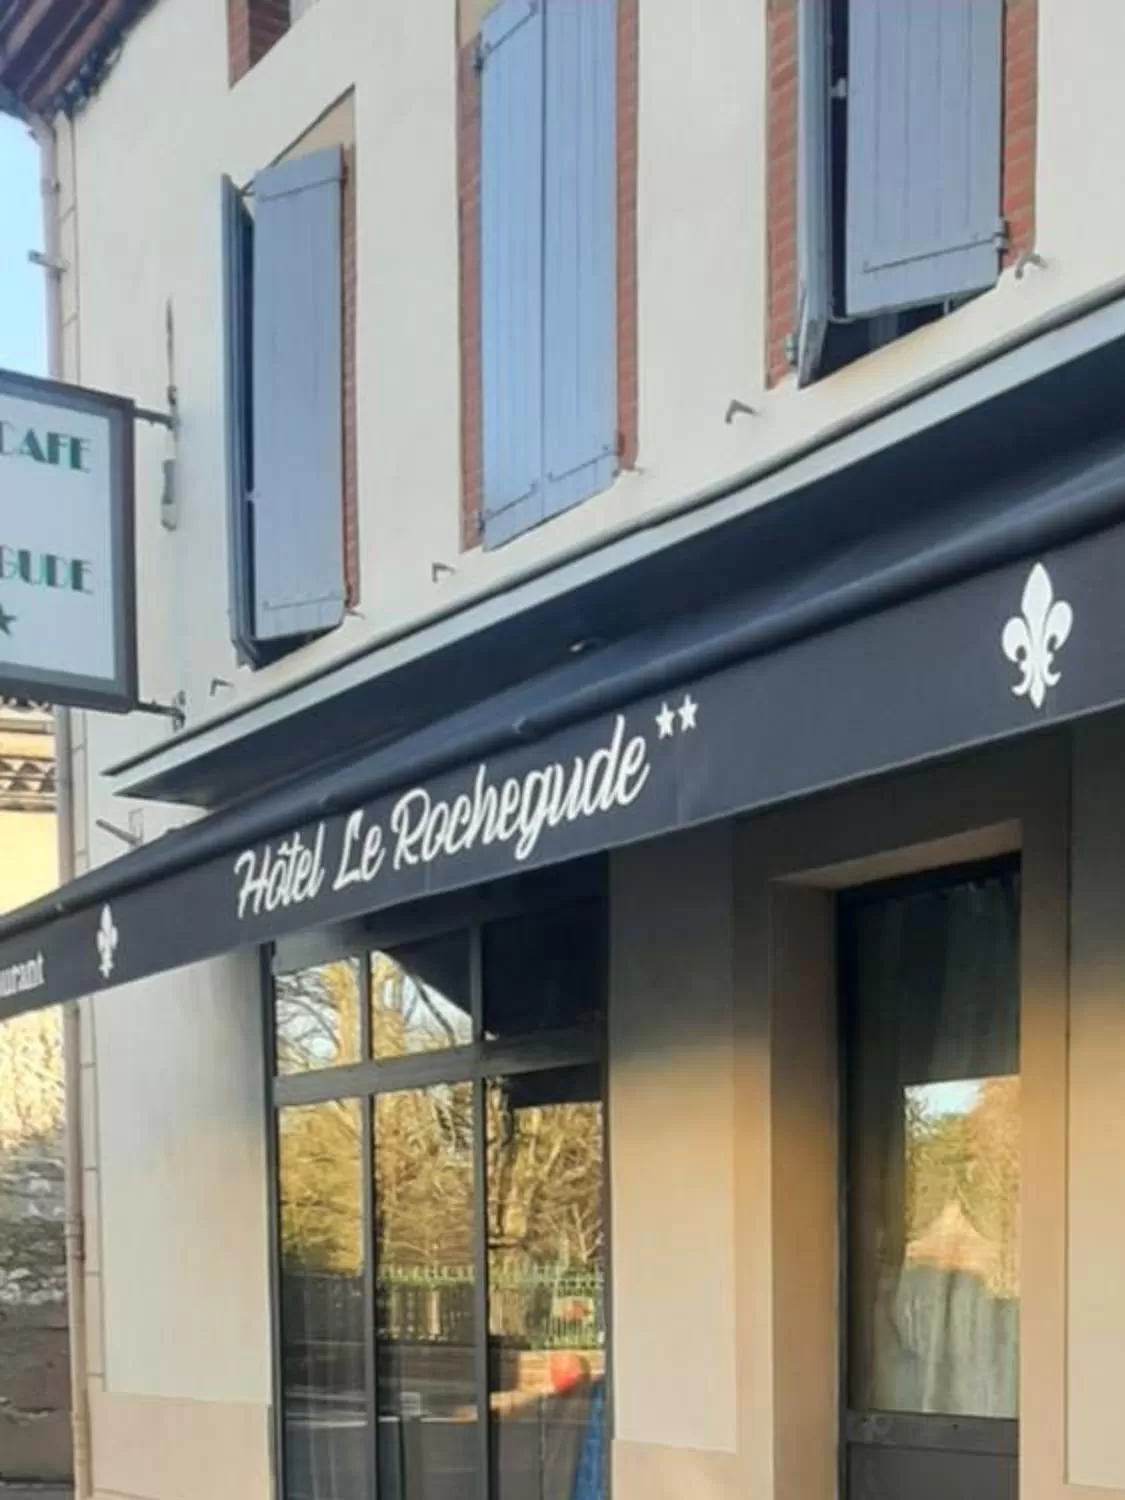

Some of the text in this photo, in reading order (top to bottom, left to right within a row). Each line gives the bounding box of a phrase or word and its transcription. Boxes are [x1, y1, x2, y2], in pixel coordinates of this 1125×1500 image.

[0, 421, 92, 475] CAFE
[233, 714, 651, 918] Hôtel Le Rochegude
